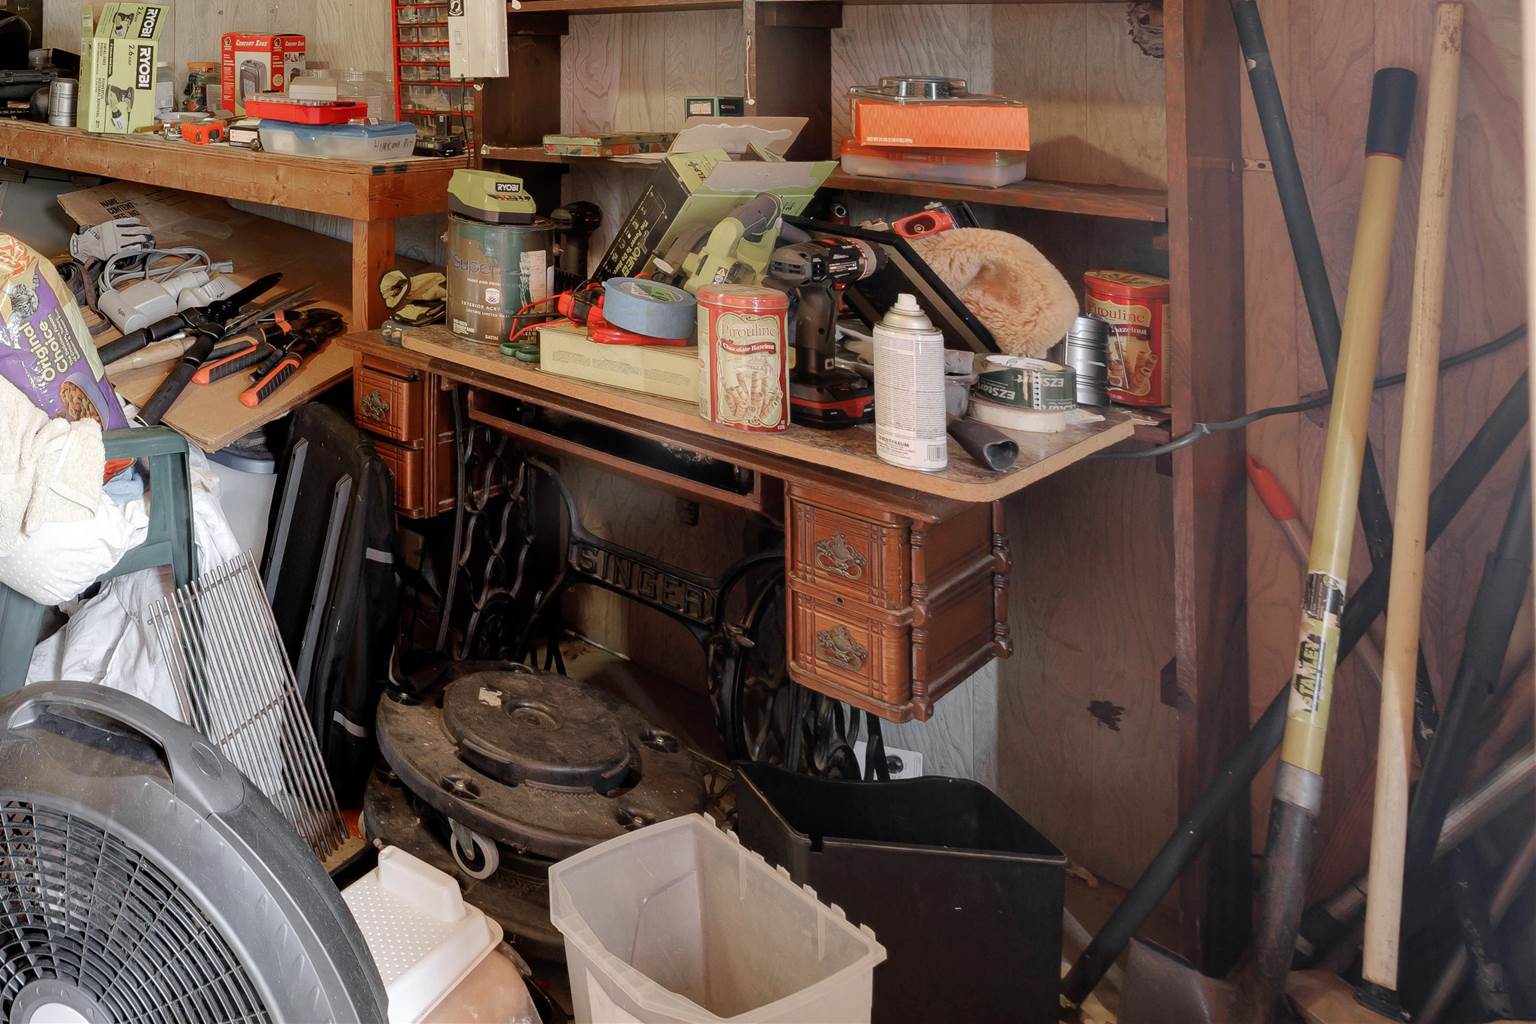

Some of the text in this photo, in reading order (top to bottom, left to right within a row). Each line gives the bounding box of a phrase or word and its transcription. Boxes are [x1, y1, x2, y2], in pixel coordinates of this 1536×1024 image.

[139, 7, 159, 38] RYOBI
[138, 46, 152, 89] RYOBI
[496, 183, 520, 192] RYOBI
[18, 321, 56, 382] Original
[39, 320, 68, 373] Choice
[576, 545, 706, 618] SINGER
